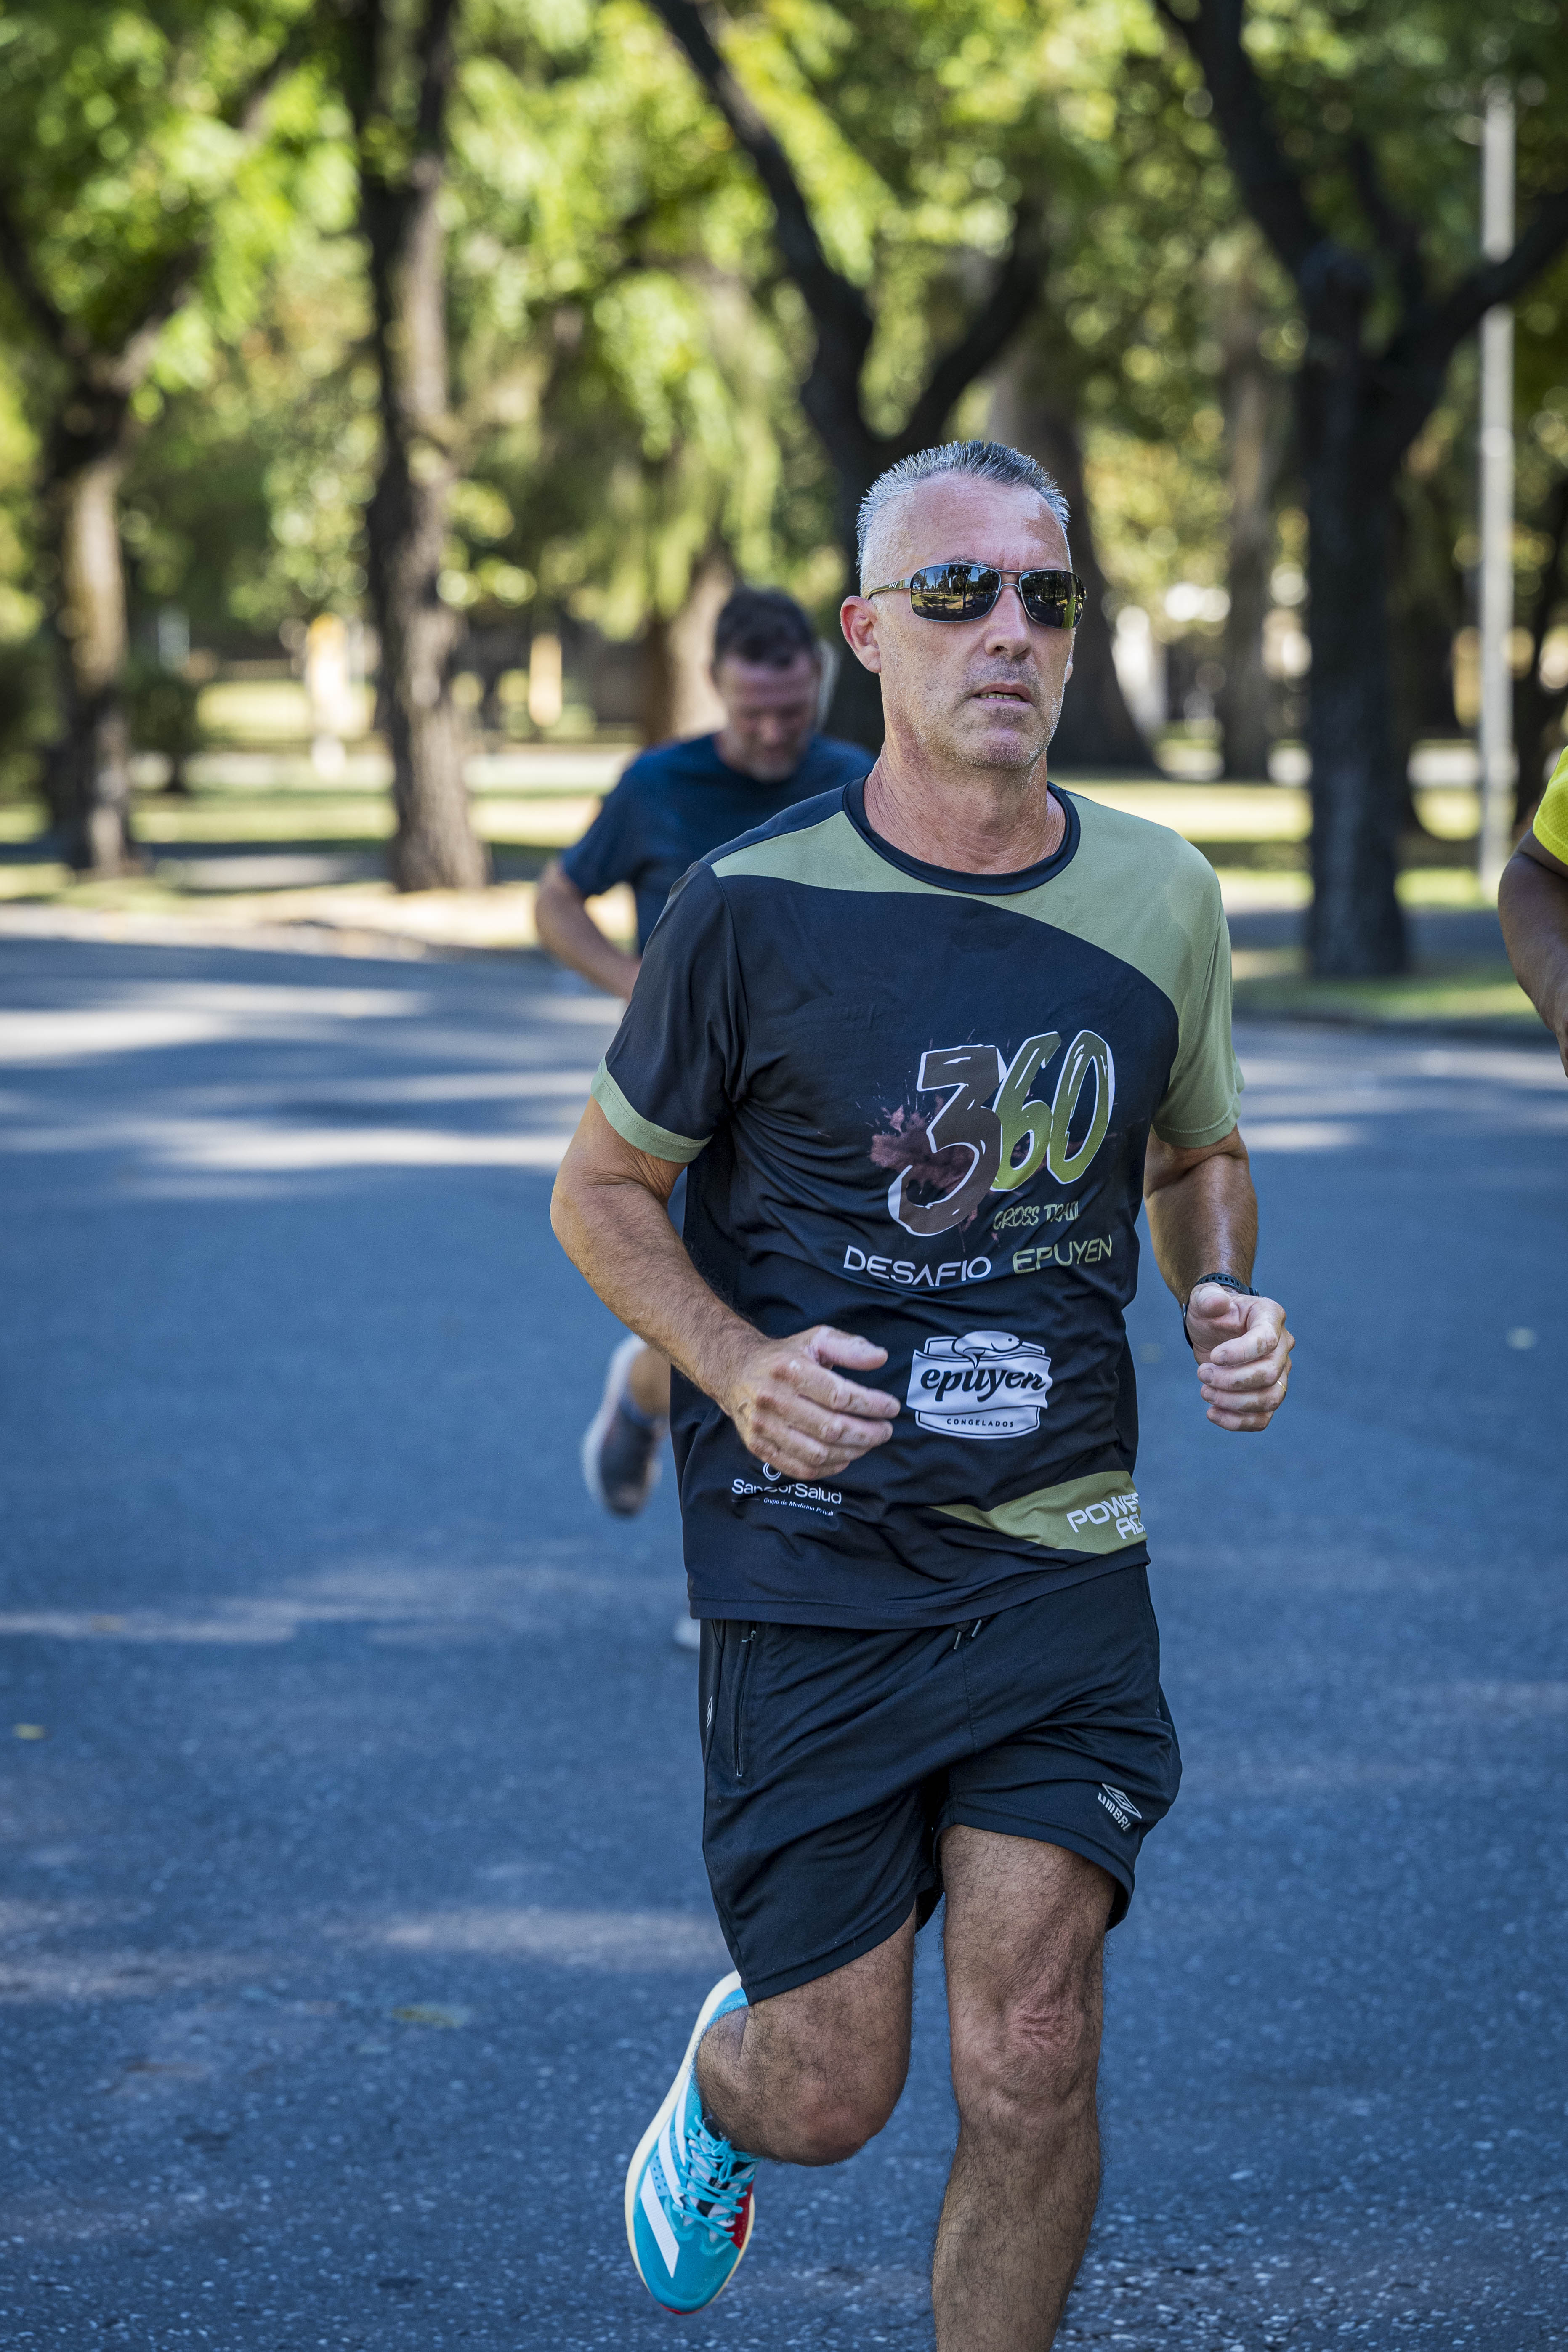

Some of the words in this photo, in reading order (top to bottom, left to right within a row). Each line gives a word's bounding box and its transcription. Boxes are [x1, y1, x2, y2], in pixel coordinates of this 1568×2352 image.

[888, 1029, 1115, 1236] 360
[993, 1205, 1040, 1230] CROSS
[843, 1245, 991, 1286] DESAFIO
[1013, 1234, 1112, 1274] EPUYEN
[920, 1369, 1047, 1402] epuyen
[946, 1418, 1014, 1427] CONGELADOS
[789, 1500, 815, 1511] Medicina
